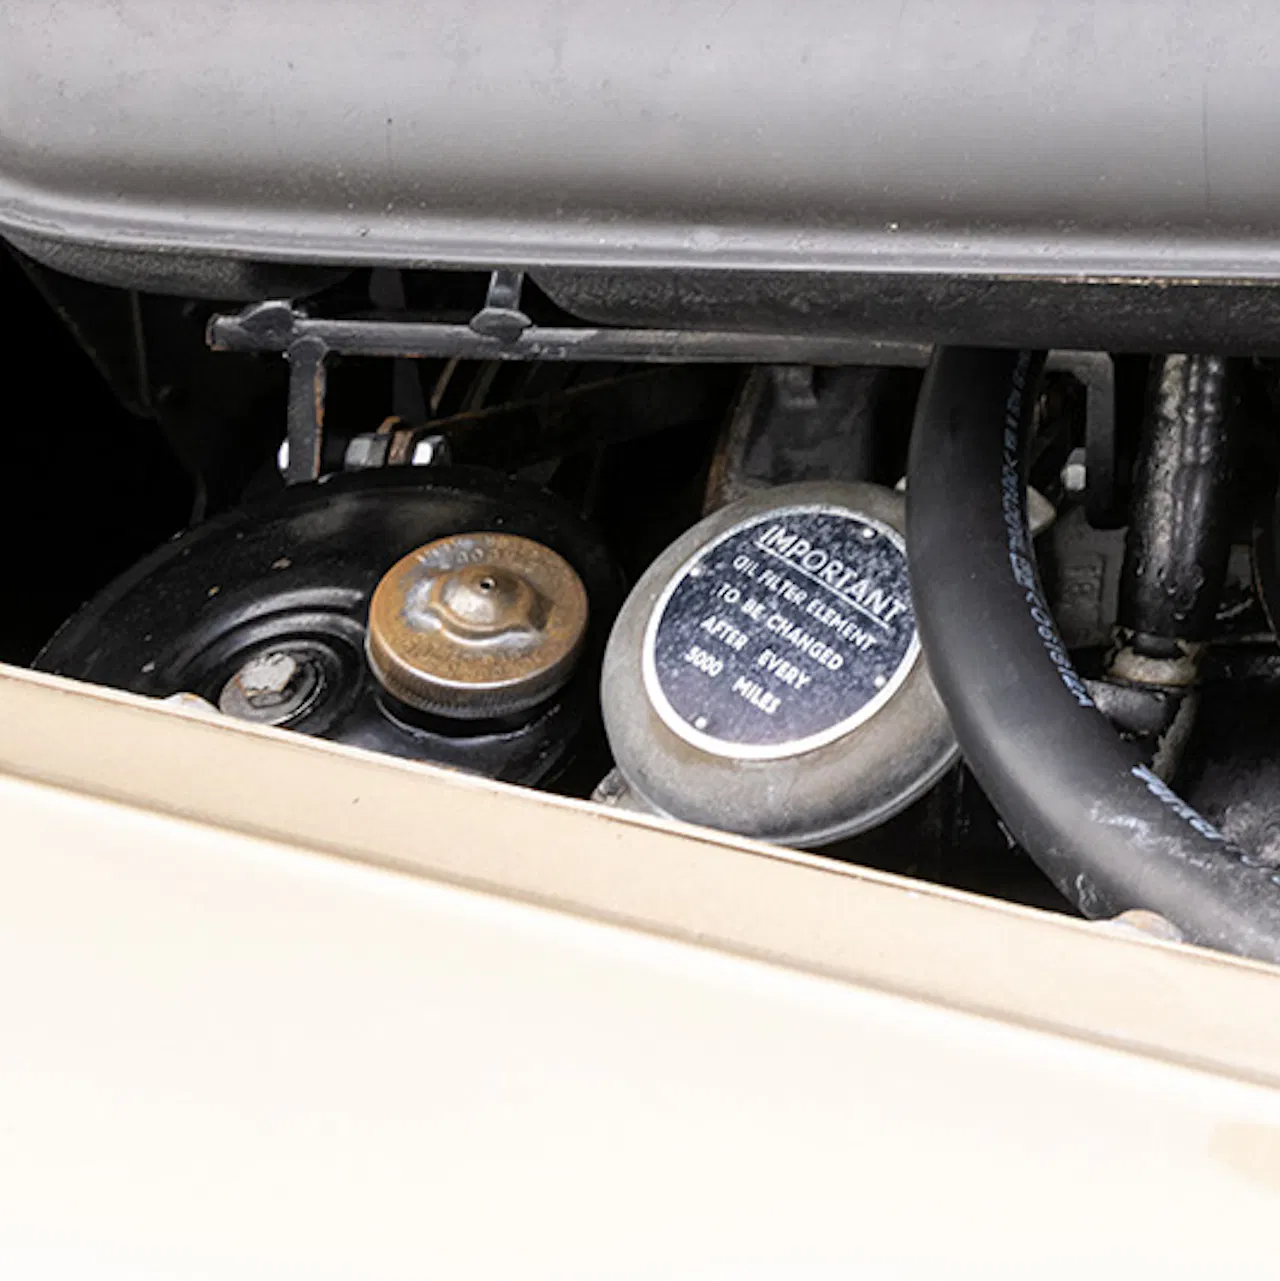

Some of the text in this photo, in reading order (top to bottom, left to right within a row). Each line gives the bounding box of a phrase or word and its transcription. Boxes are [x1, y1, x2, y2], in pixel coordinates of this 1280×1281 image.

[733, 555, 876, 651] OIL FILTER ELEMENT
[760, 526, 906, 621] IMPORTANT
[700, 616, 811, 690] AFTER EVERY
[718, 583, 844, 670] TO BE CHANGED
[685, 647, 782, 714] 5000 MILES
